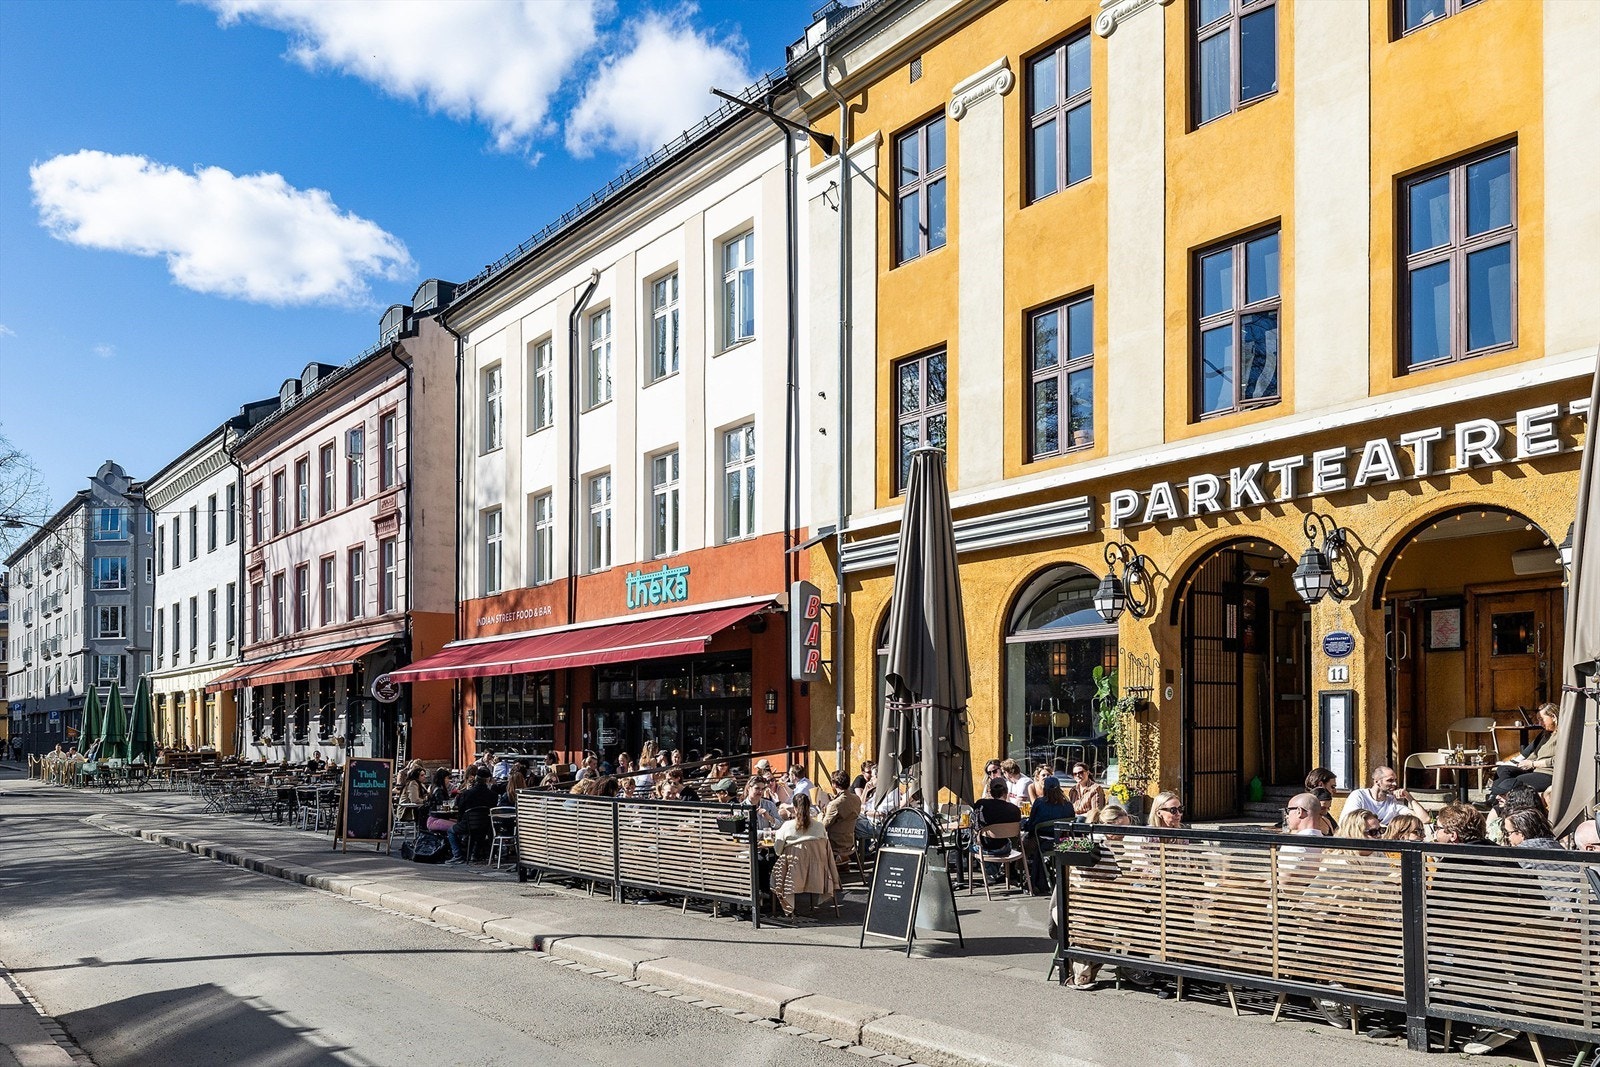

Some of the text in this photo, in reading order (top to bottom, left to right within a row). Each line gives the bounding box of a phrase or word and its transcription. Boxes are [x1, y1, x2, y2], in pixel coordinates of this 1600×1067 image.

[626, 564, 690, 610] theka
[476, 605, 552, 627] INDIAN STREET FOOD & BAR
[803, 594, 821, 674] BAR
[1331, 668, 1344, 681] 11
[358, 770, 377, 778] Thali
[353, 779, 372, 788] Lunch
